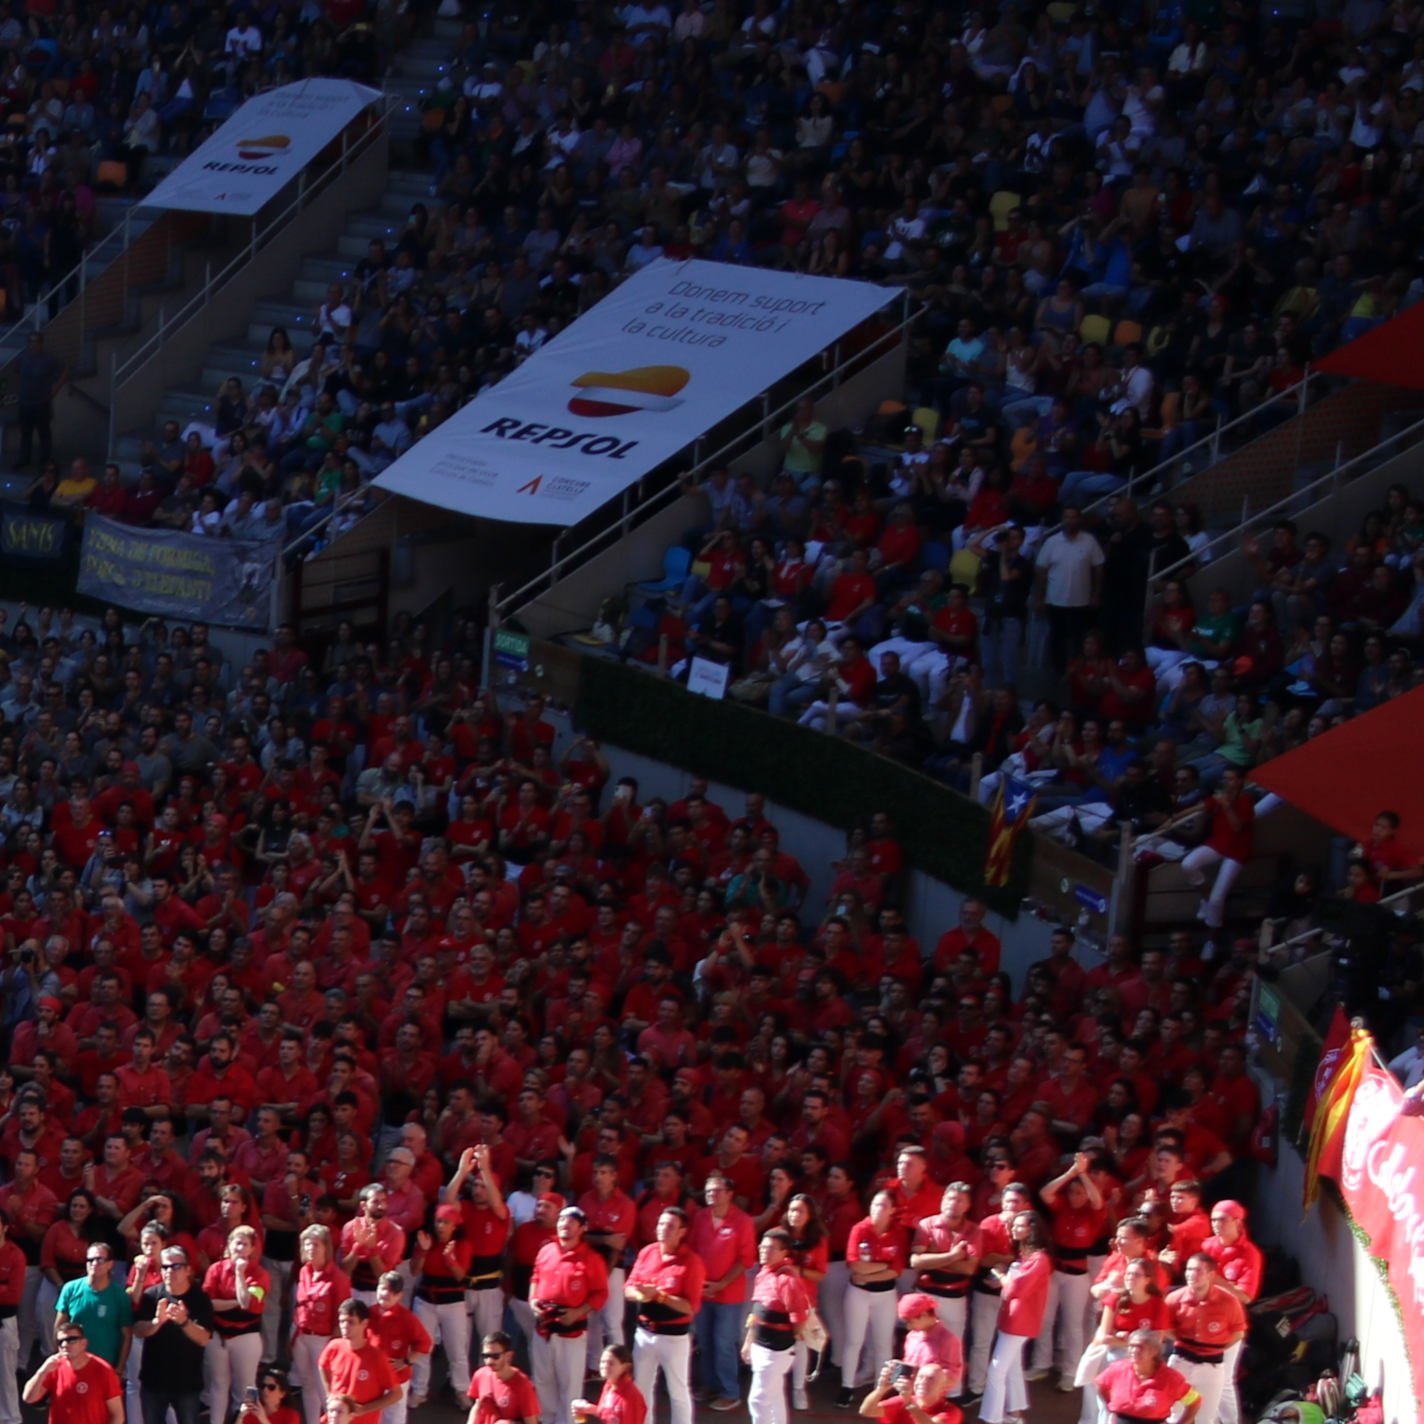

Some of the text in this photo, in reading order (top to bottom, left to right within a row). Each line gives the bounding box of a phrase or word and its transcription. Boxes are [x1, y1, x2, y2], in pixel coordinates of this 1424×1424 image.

[202, 161, 280, 176] REPSOL
[668, 280, 827, 316] Donem suport
[621, 318, 728, 348] la cultura
[644, 302, 665, 314] a
[664, 302, 690, 319] la
[690, 308, 778, 333] tradició
[480, 416, 641, 462] REPSOL
